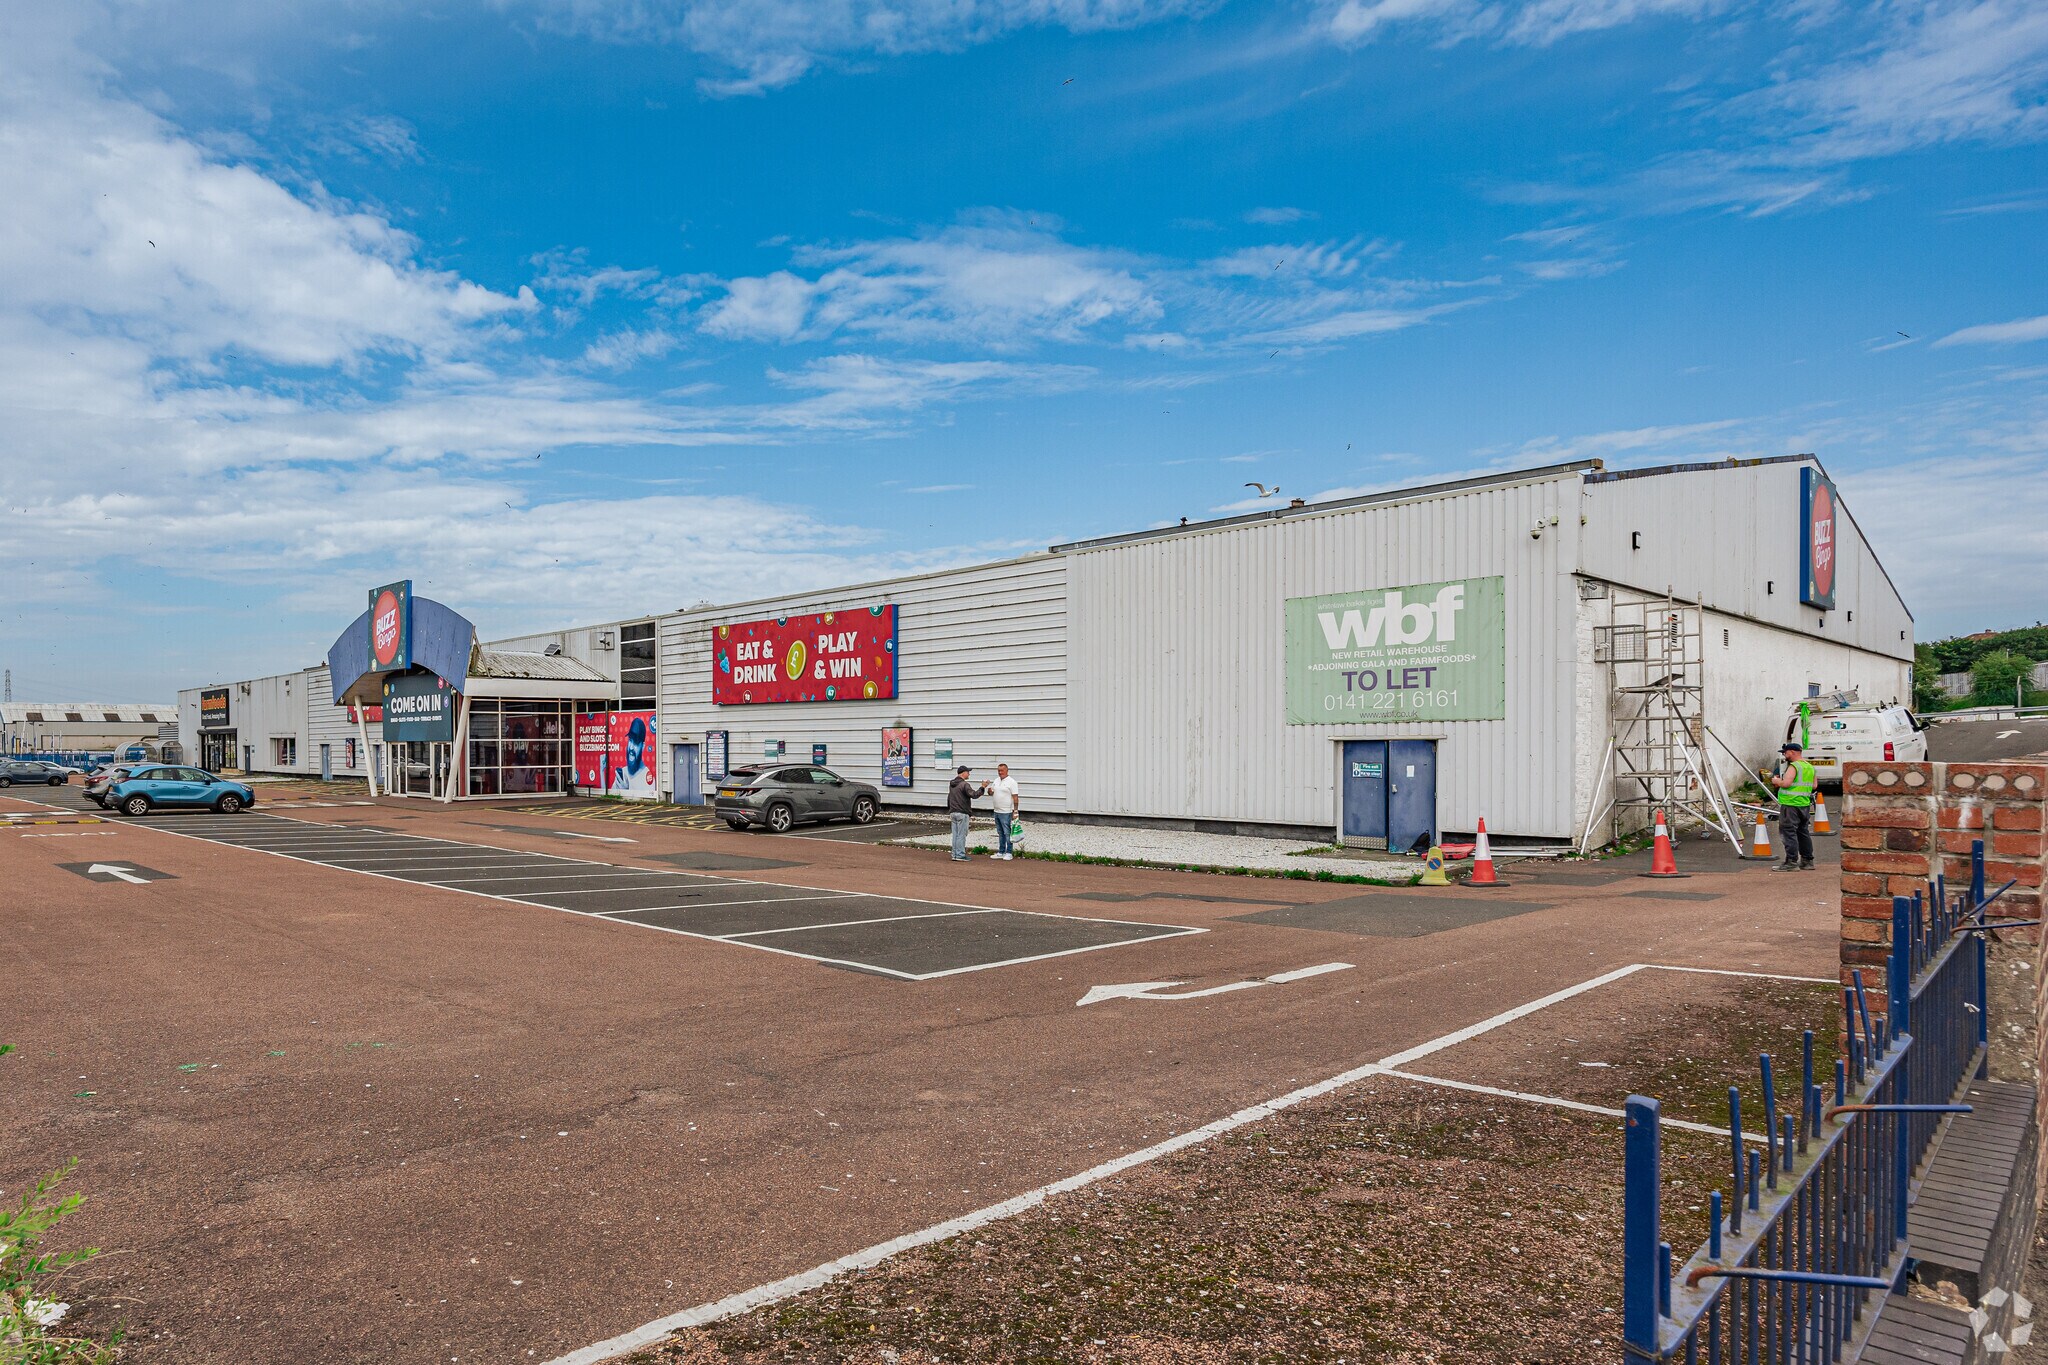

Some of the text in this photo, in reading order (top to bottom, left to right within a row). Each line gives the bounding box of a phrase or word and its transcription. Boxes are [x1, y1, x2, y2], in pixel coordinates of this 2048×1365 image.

[1814, 519, 1831, 546] BUZZ
[1815, 545, 1831, 571] Bingo
[376, 608, 396, 636] BUZZ
[1317, 584, 1464, 650] wbf
[377, 627, 396, 649] Bingo
[818, 631, 858, 654] PLAY
[736, 640, 774, 661] EAT &
[1332, 644, 1447, 660] NEW RETAIL WAREHOUSE
[814, 657, 862, 680] & WIN
[1361, 659, 1385, 668] GALA
[1387, 658, 1407, 667] AND
[734, 664, 777, 684] DRINK
[1341, 666, 1438, 692] TO LET
[390, 693, 442, 714] COME ON IN
[1324, 689, 1458, 711] 0141 221 6161
[1359, 709, 1418, 719] www.wbf.co.uk
[546, 720, 565, 735] Helo
[579, 726, 591, 734] PLAY
[579, 735, 590, 743] AND
[590, 734, 605, 743] SLOTS
[579, 743, 620, 752] BUZZBINGOCOM
